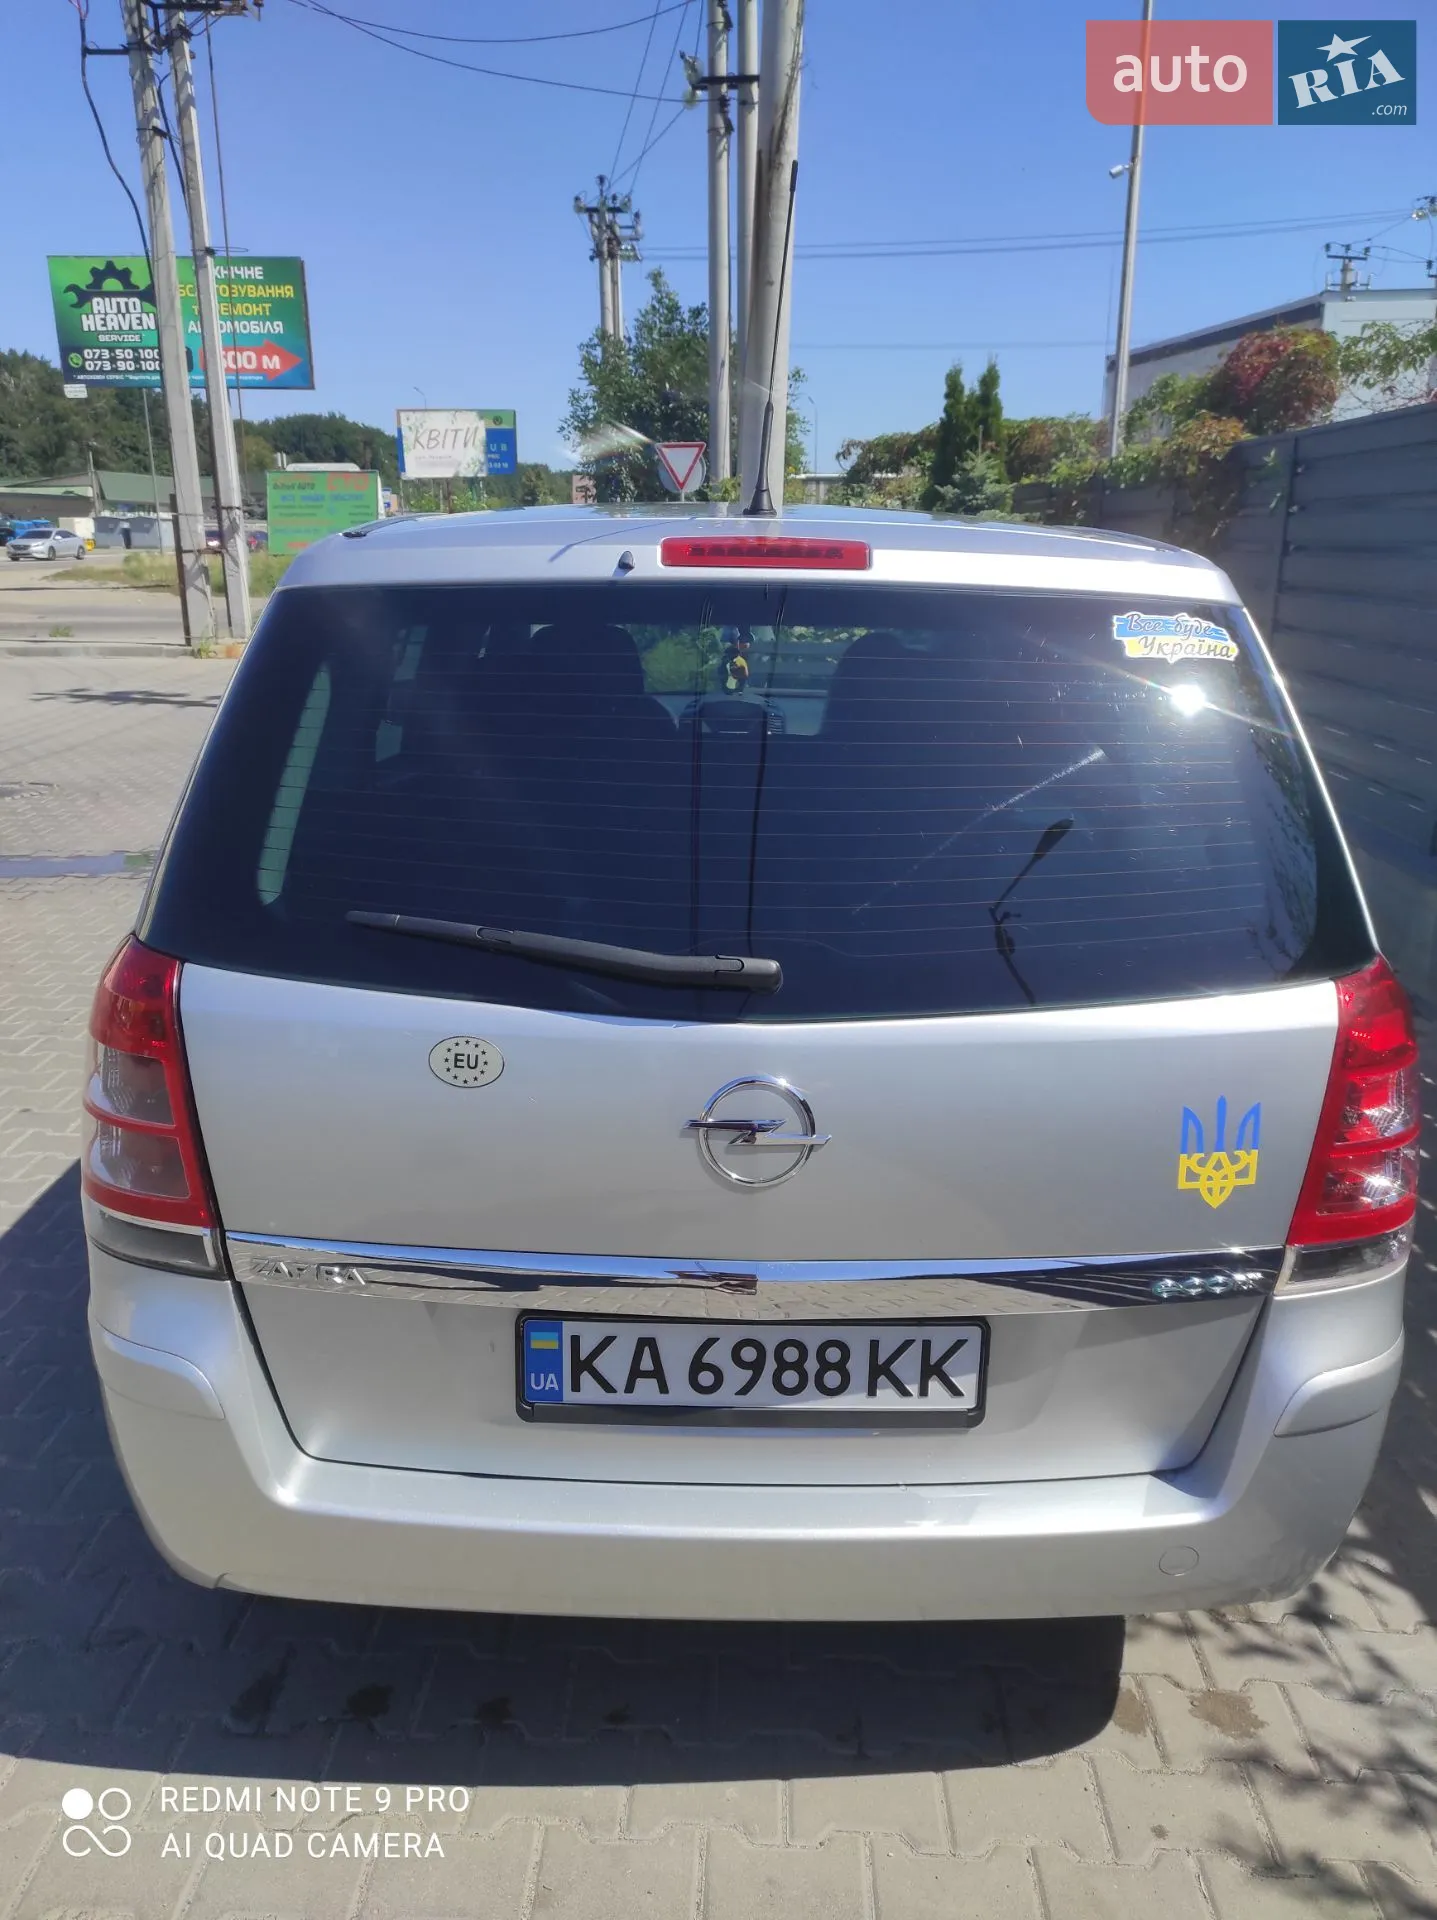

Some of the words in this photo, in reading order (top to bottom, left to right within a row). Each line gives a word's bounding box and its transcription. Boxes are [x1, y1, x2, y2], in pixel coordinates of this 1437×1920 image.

[91, 297, 142, 314] AUTO
[220, 303, 272, 316] ЕМОНТ
[81, 313, 156, 331] HEAVEN
[98, 334, 141, 342] SERVICE
[413, 427, 479, 450] КВІТИ
[1127, 613, 1163, 631] Все
[1174, 614, 1214, 641] буде
[1138, 636, 1234, 659] Україна
[453, 1053, 479, 1070] EU
[530, 1372, 559, 1391] UA
[569, 1334, 670, 1395] KA
[688, 1337, 852, 1397] 6988
[867, 1338, 969, 1399] KK
